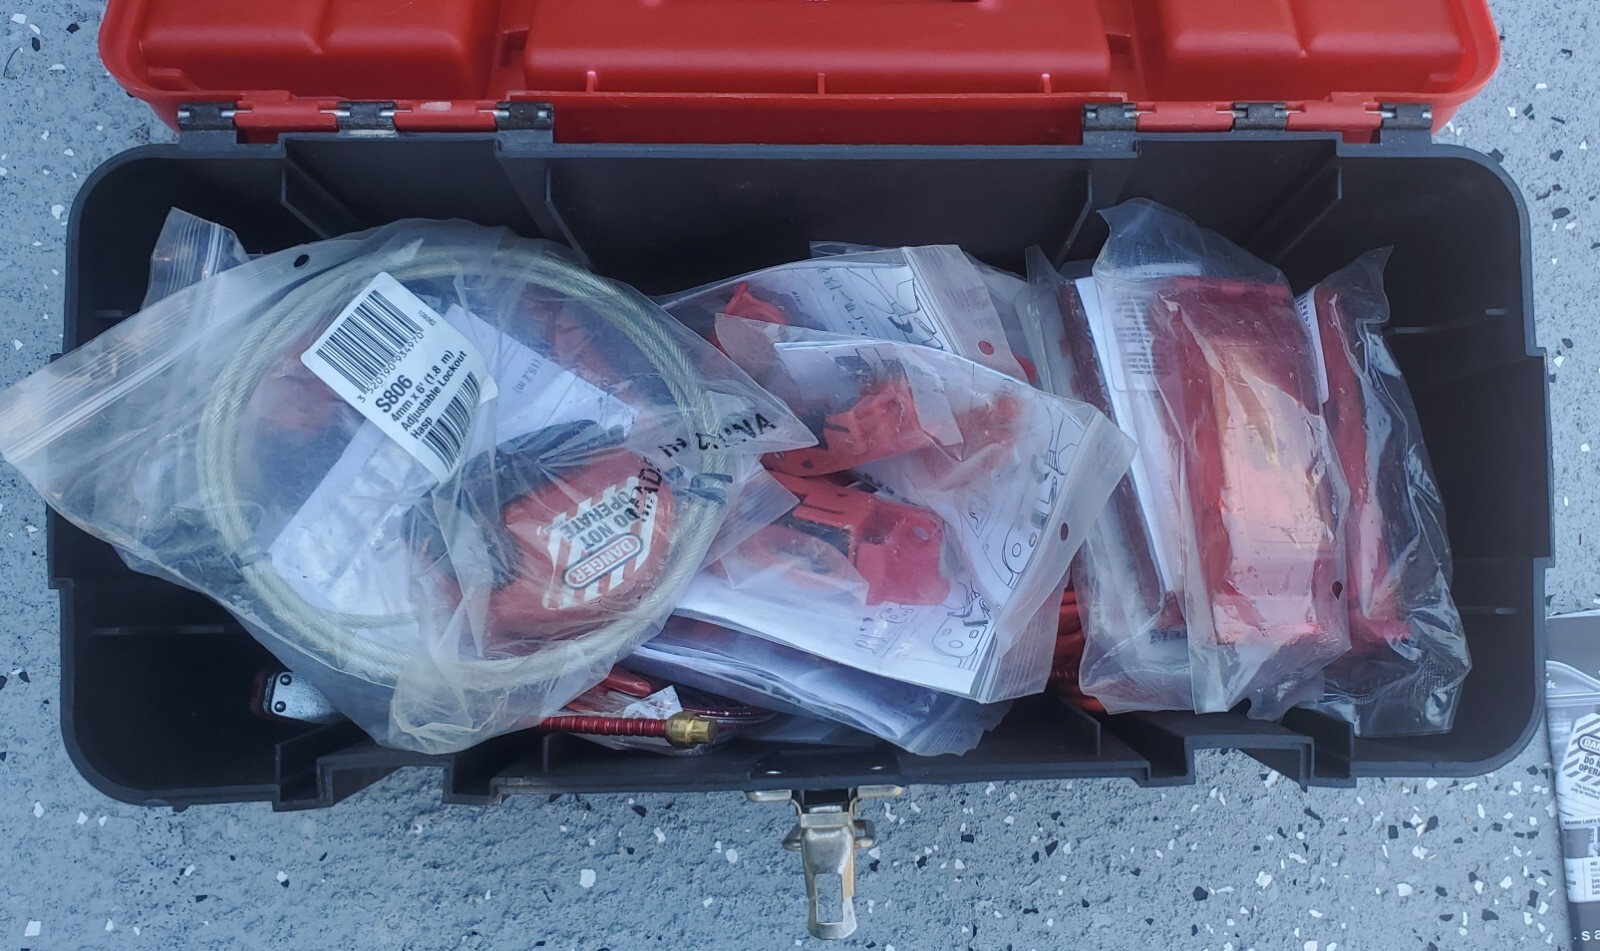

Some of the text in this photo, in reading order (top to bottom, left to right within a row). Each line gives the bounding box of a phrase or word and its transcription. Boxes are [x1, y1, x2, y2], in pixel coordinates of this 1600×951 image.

[357, 331, 424, 403] 3 520190 934970
[391, 350, 454, 422] 4mm x 6' (1.8 m)
[375, 374, 413, 413] S806
[401, 350, 467, 431] Adjustable Lockout
[410, 416, 433, 440] Hasp
[560, 491, 632, 540] OPERATE
[613, 507, 638, 528] DO
[580, 523, 615, 550] NOT
[571, 538, 634, 582] DANGER
[1584, 756, 1595, 766] DO
